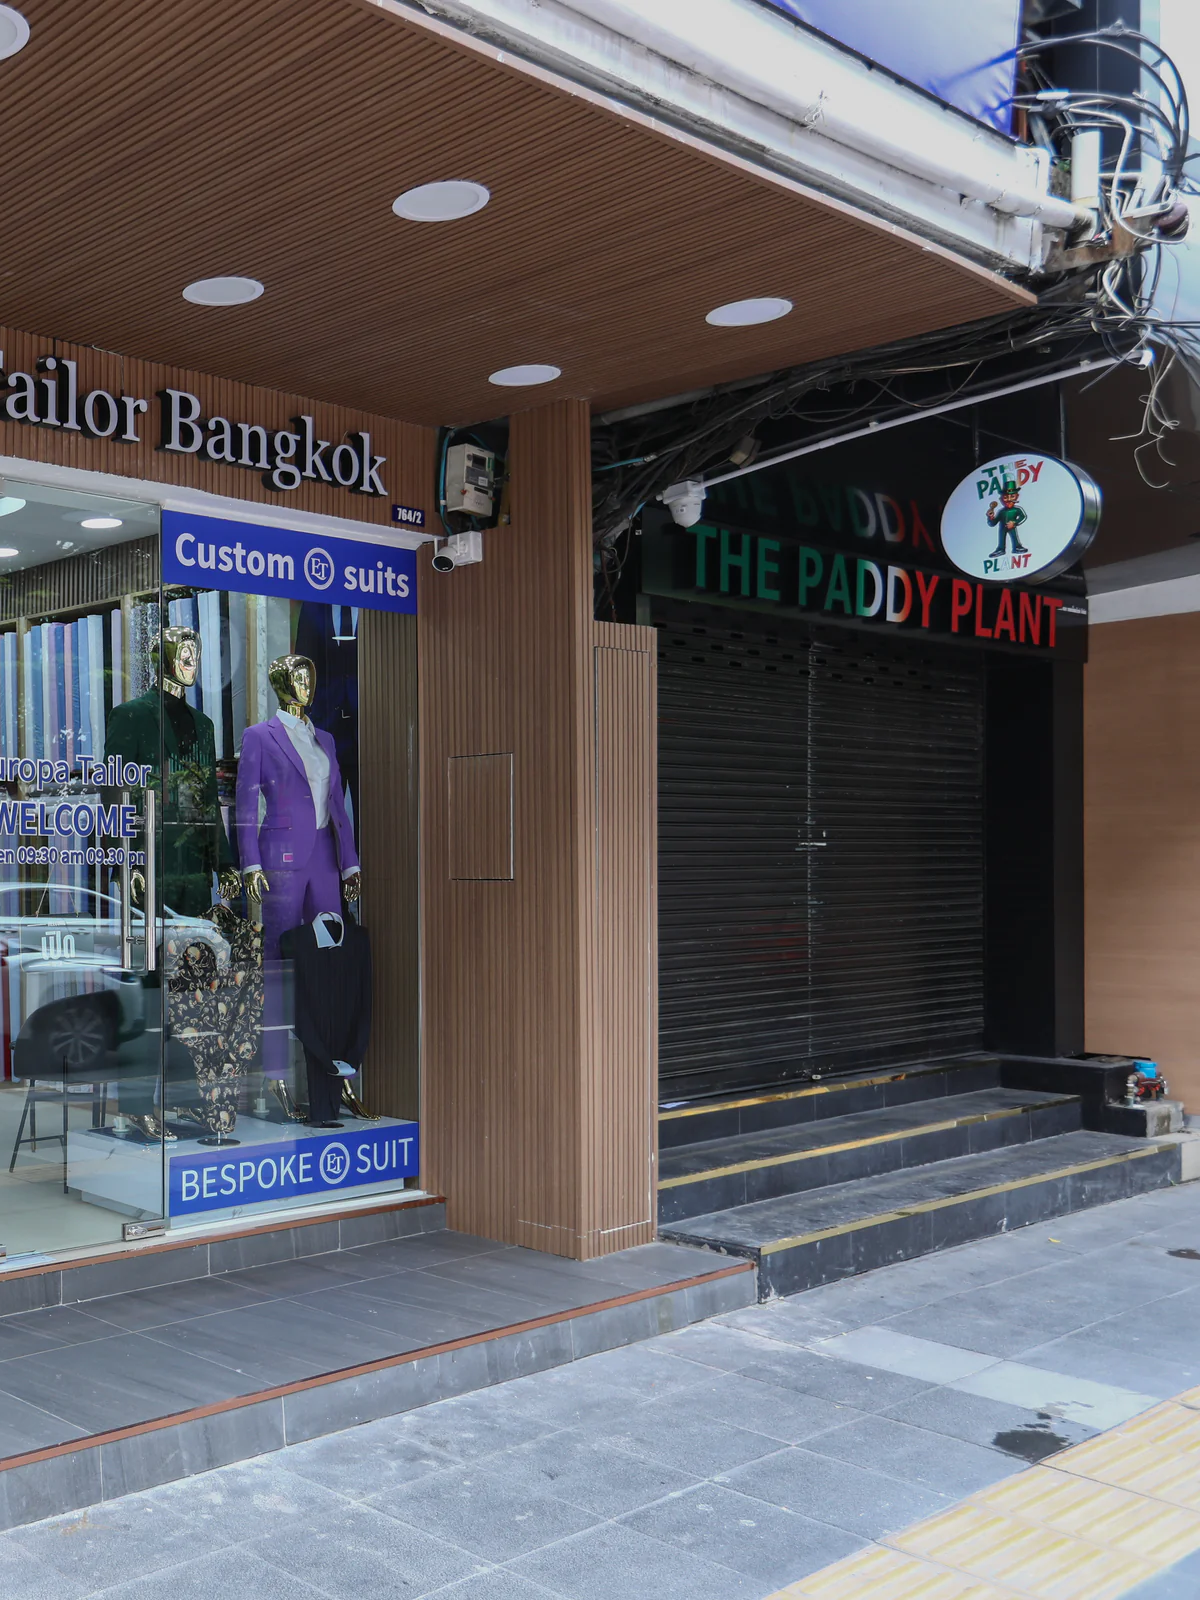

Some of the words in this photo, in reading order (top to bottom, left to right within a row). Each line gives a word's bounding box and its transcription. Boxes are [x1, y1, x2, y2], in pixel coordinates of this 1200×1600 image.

[161, 389, 388, 496] Bangkok
[976, 461, 1043, 500] PADDY
[981, 459, 1027, 478] THE
[397, 507, 422, 525] 764/2
[175, 532, 295, 580] Custom
[344, 561, 409, 598] suits
[983, 553, 1032, 574] PLANT
[687, 524, 780, 600] THE
[799, 546, 939, 629] PADDY
[951, 578, 1063, 648] PLANT
[76, 754, 151, 788] Tailor
[60, 849, 85, 865] am
[181, 1152, 313, 1202] BESPOKE
[356, 1137, 414, 1174] SUIT
